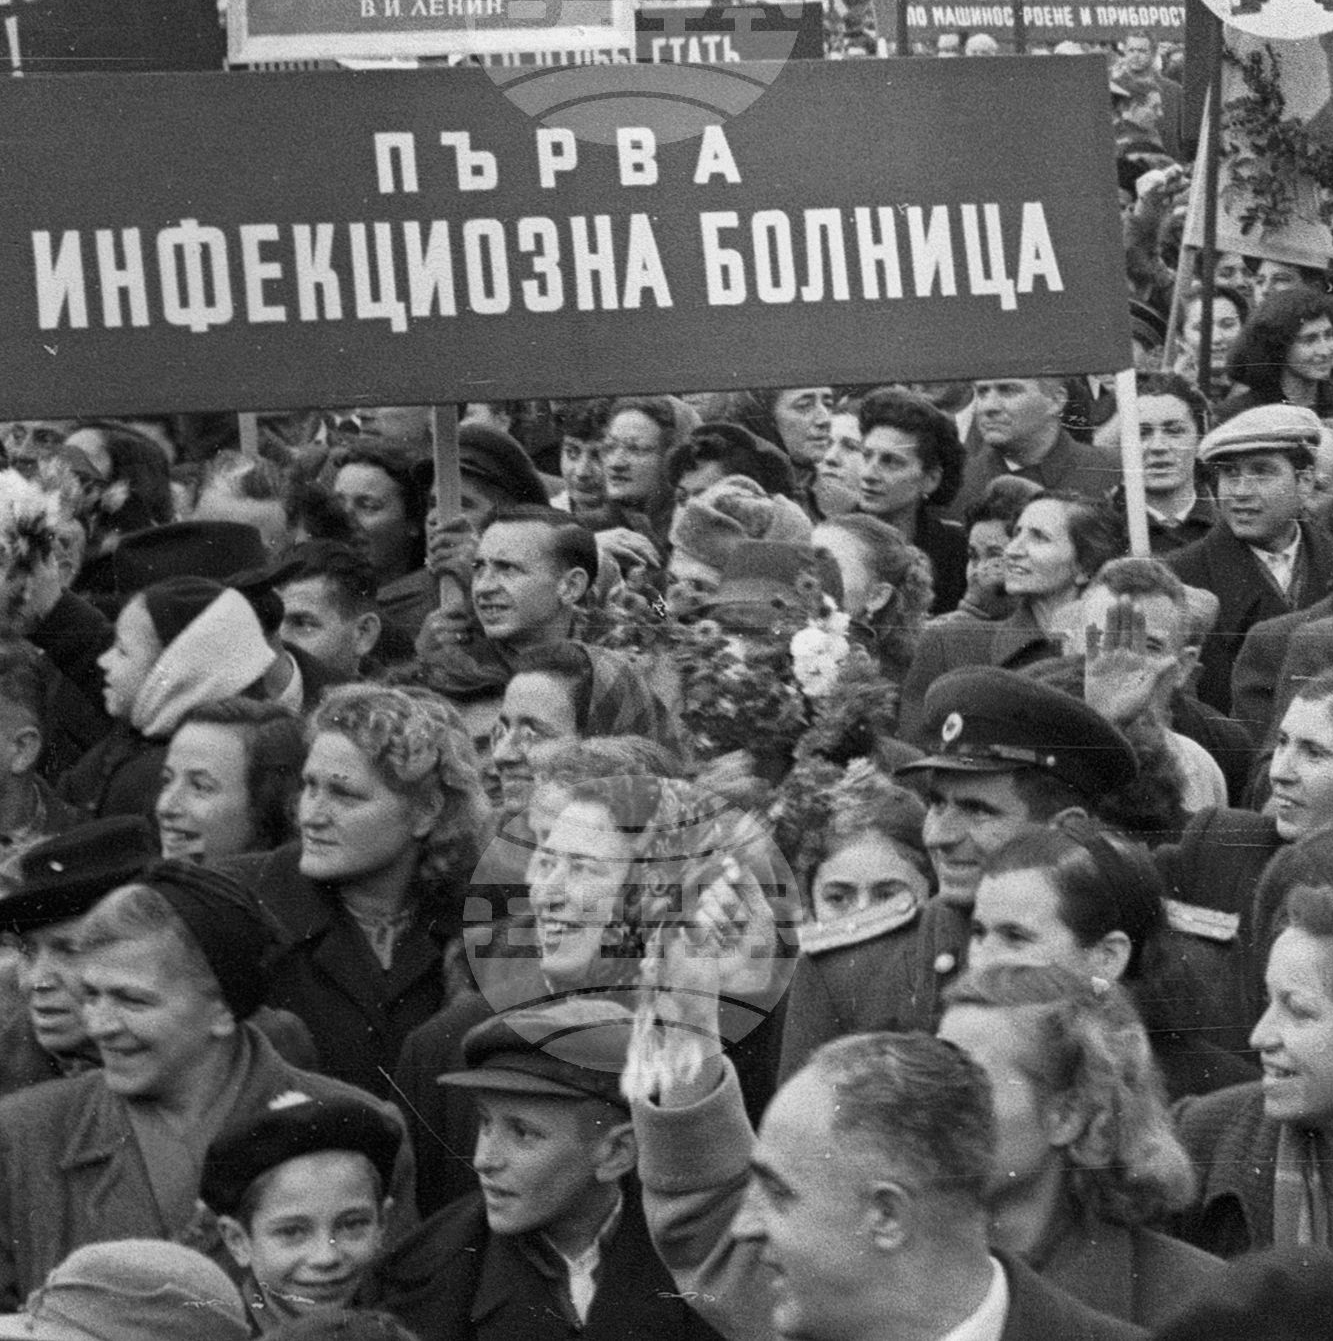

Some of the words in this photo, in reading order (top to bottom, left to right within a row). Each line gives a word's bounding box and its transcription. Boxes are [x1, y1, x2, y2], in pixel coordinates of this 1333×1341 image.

[373, 125, 742, 194] ПЪРВА
[30, 212, 674, 333] ИНФЕКЦИОЗНА
[700, 201, 1064, 312] БОЛНИЦА
